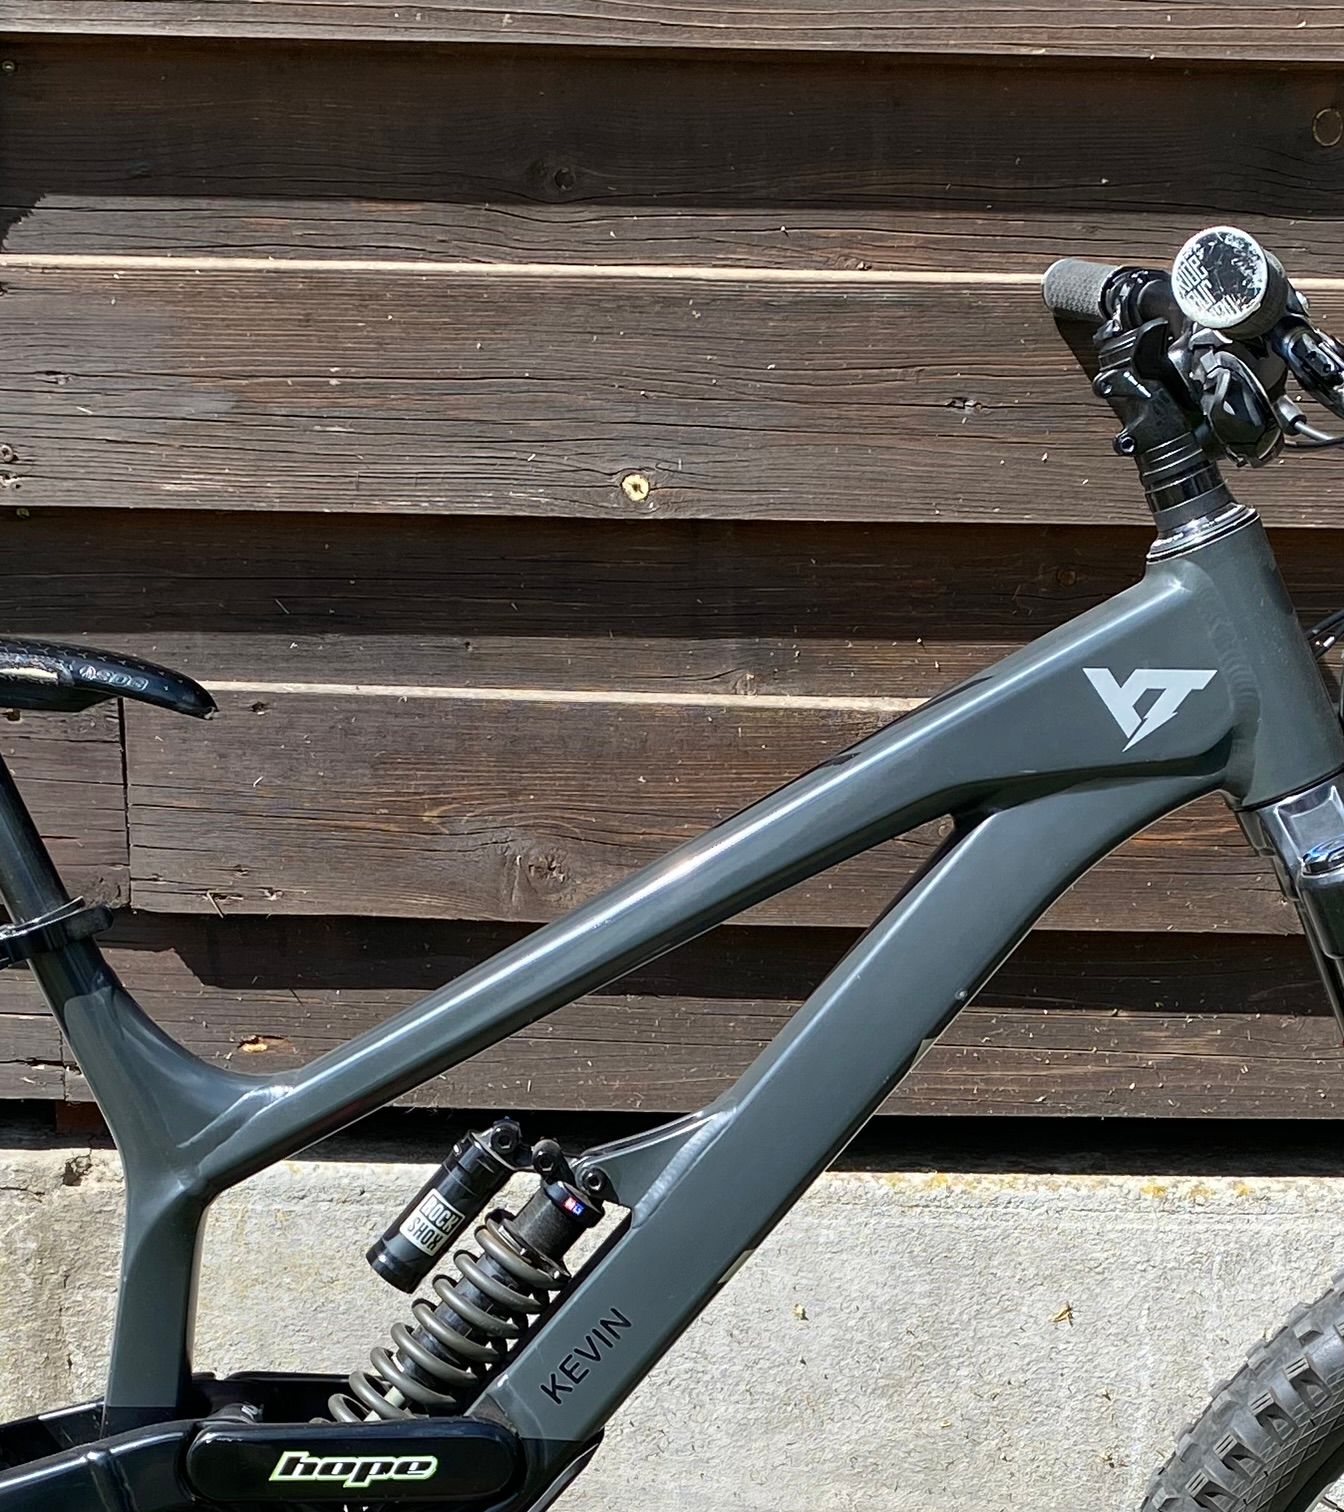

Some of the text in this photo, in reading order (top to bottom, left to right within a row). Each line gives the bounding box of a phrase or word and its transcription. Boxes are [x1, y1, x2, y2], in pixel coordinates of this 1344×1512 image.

[1083, 667, 1218, 752] YT
[407, 1216, 444, 1252] SHOX
[421, 1200, 460, 1234] ROCK
[539, 1308, 633, 1405] KEVIN
[269, 1450, 440, 1488] hope
